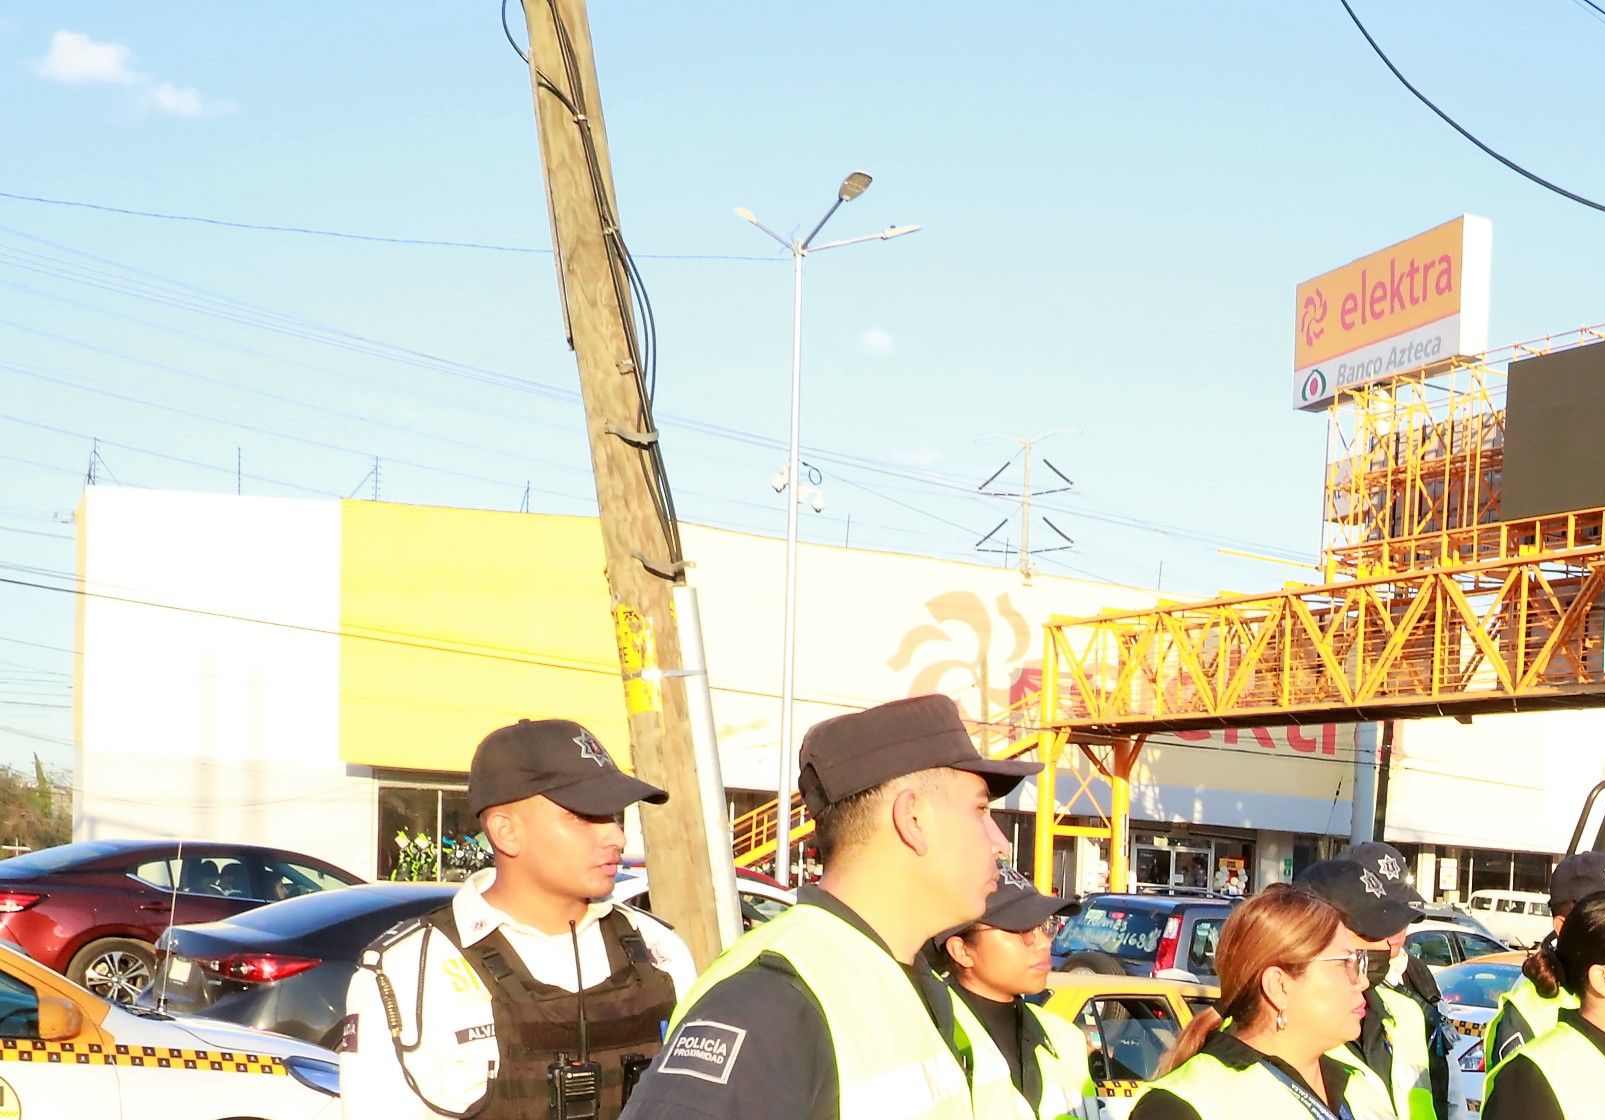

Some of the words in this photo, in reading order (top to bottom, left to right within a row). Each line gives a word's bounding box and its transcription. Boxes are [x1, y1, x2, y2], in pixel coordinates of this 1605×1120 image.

[1340, 254, 1452, 330] elektra
[1337, 356, 1383, 385] Banco
[1386, 336, 1442, 369] Azteca
[673, 1048, 725, 1065] PROXIMIDAD
[677, 1036, 727, 1056] POLICÍA
